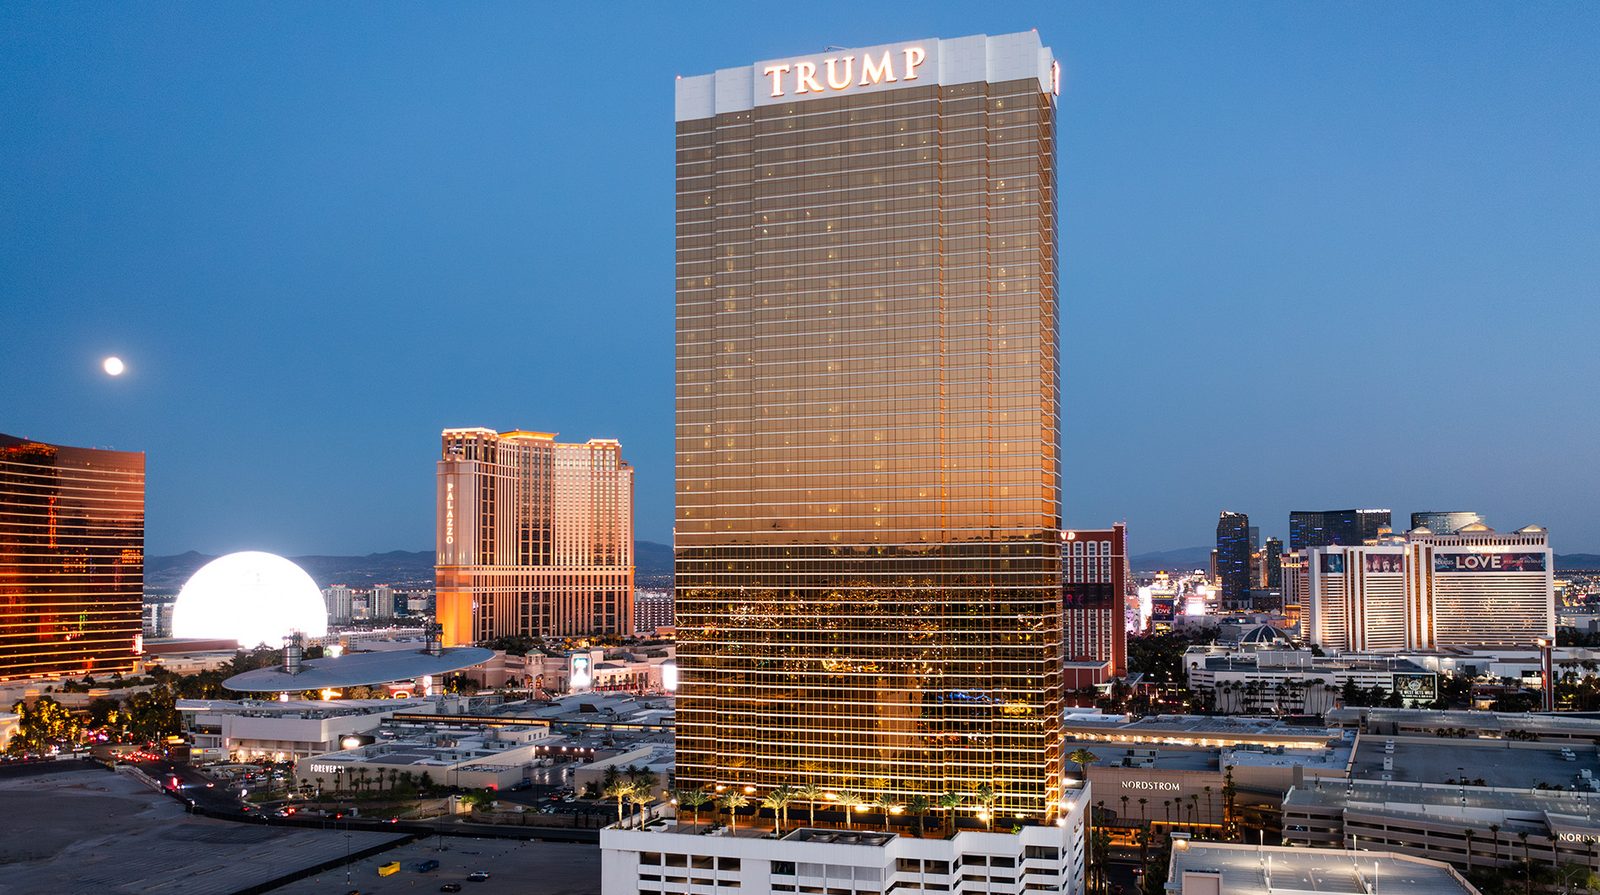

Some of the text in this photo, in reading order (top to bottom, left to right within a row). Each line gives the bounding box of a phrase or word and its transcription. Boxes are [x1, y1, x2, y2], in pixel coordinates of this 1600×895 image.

[764, 47, 926, 98] TRUMP
[446, 483, 454, 544] PALAZZO
[1456, 556, 1502, 569] LOVE
[310, 764, 336, 773] FOREVER
[1121, 781, 1180, 791] NORDSTROM
